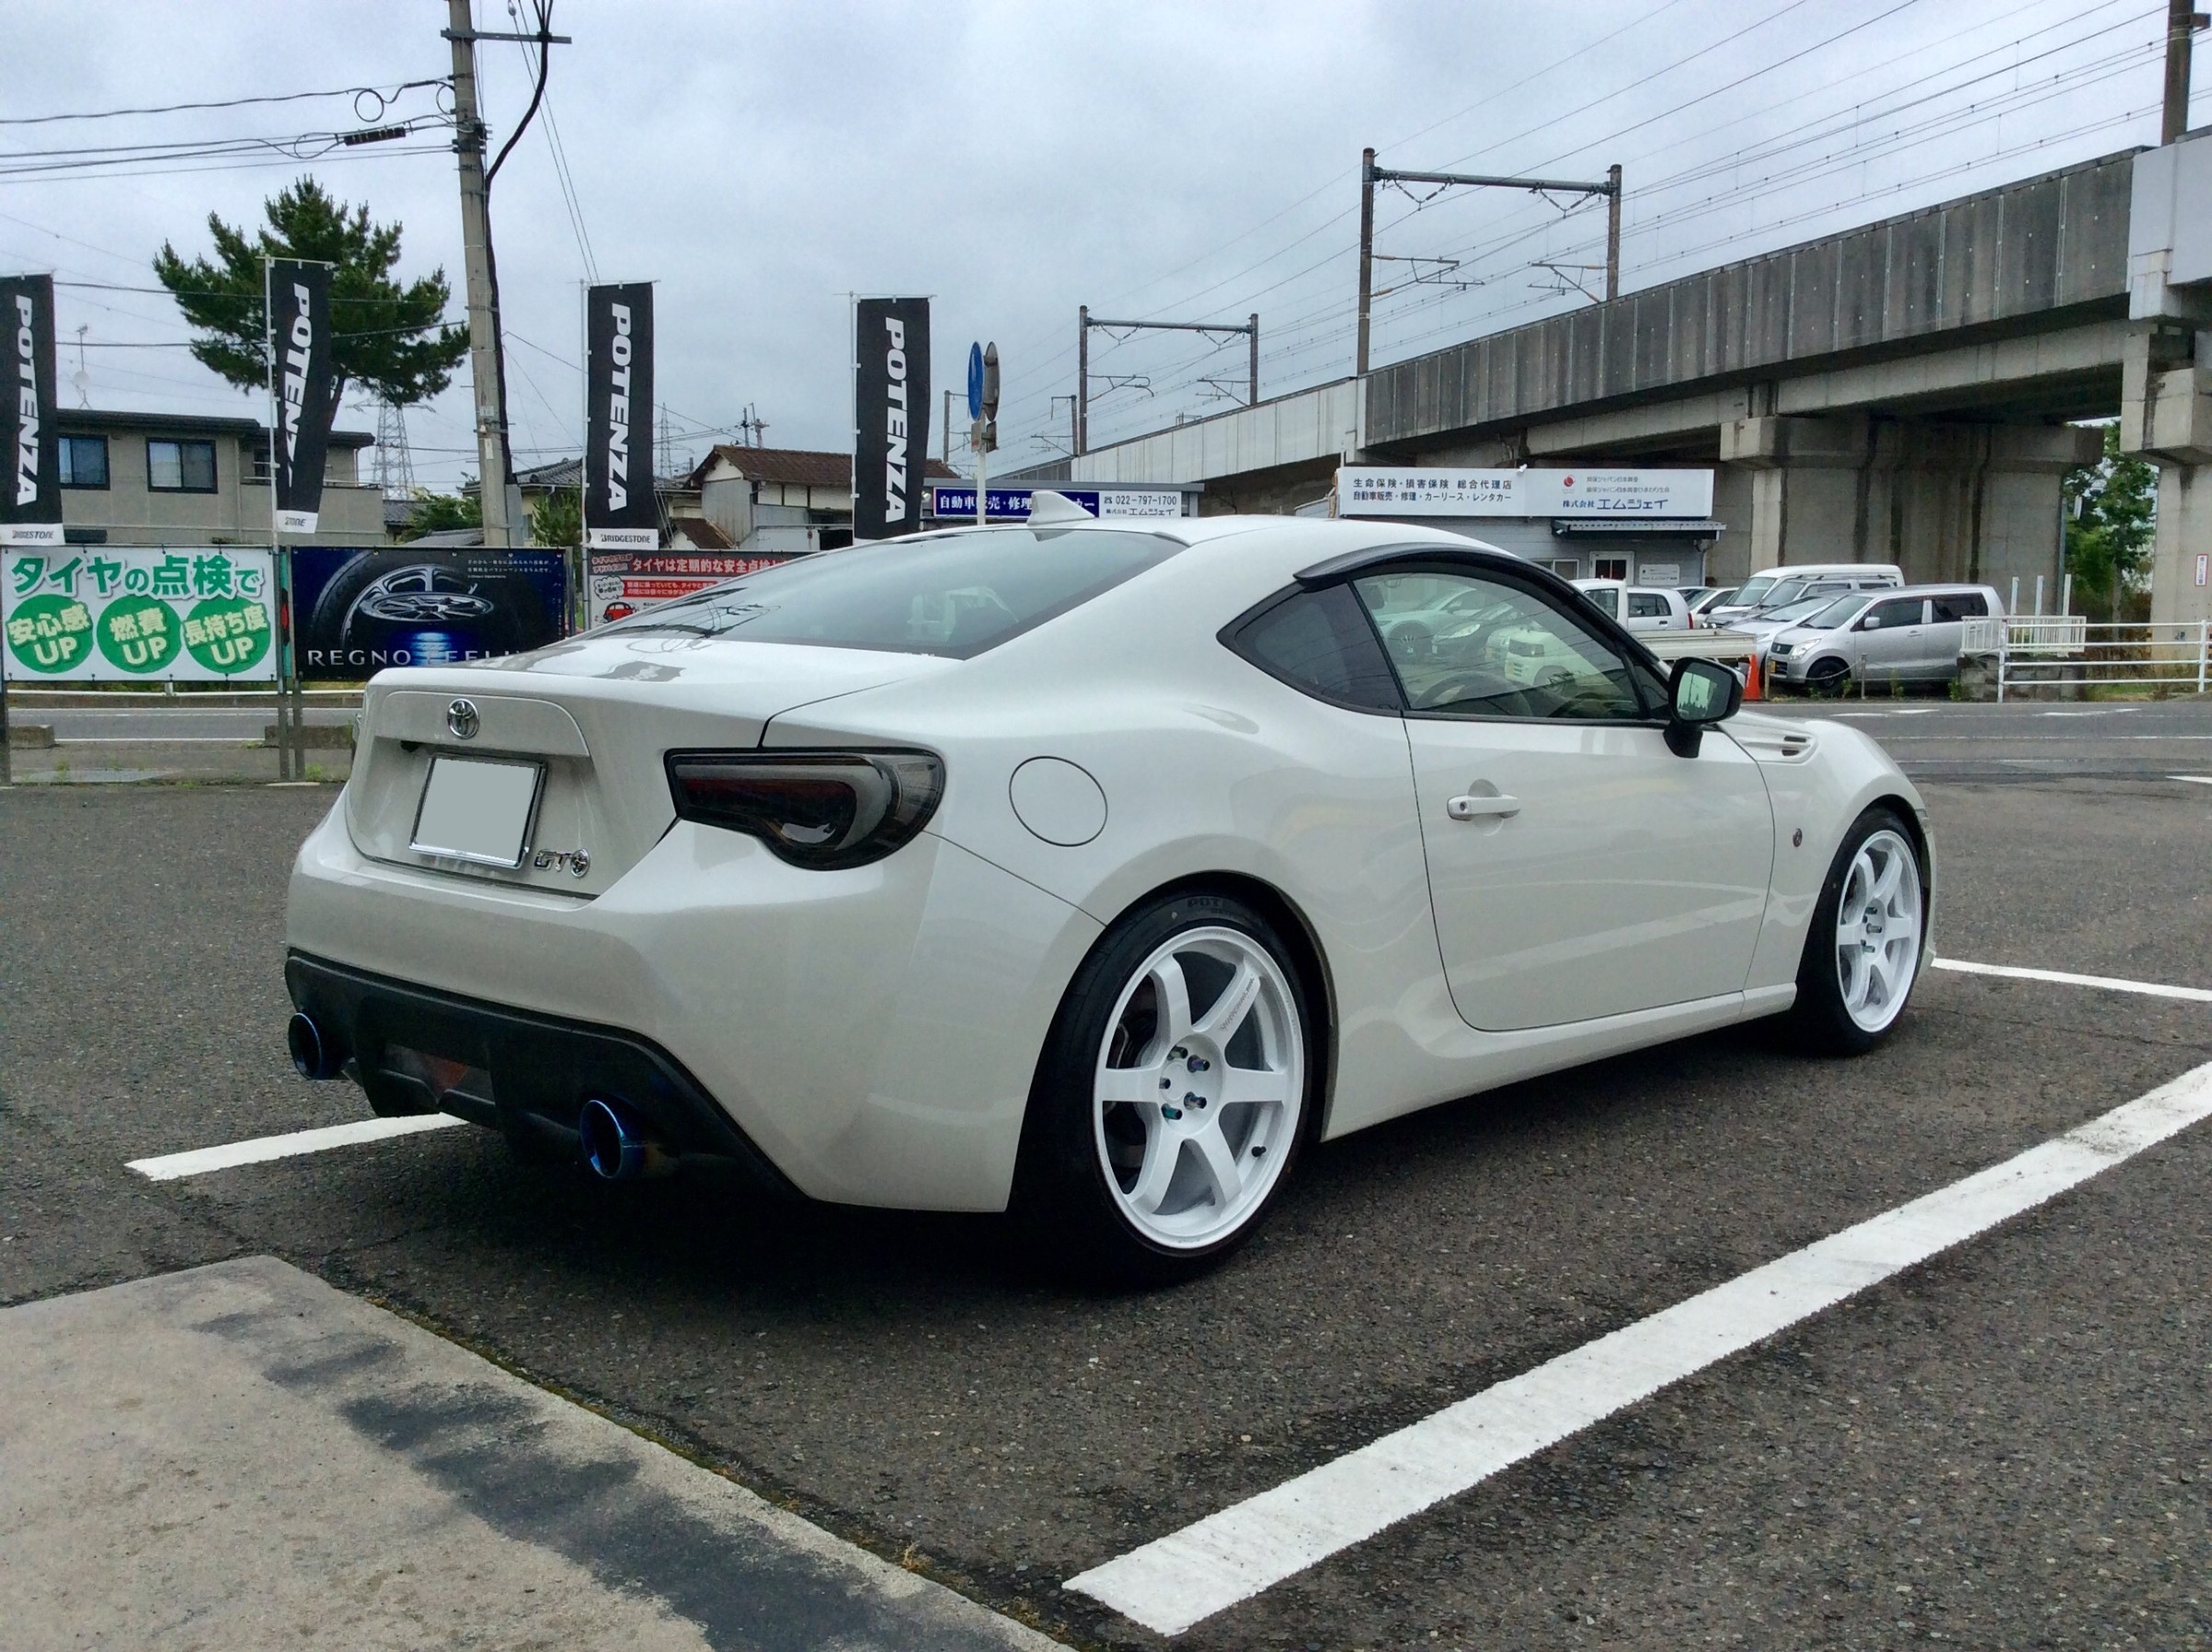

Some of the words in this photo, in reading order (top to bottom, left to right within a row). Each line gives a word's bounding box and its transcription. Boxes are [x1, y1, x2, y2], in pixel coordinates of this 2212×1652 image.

[284, 282, 312, 488] POTENZ
[16, 294, 40, 506] POTENZA
[608, 303, 632, 512] POTENZA
[885, 316, 908, 523] POTENZA
[1353, 478, 1450, 488] 生命保険・損害保険
[1457, 479, 1512, 489] 総合代理店
[1116, 495, 1177, 505] 022-797-1700
[1129, 508, 1175, 516] エムジェイ
[1597, 499, 1668, 510] エムジェイ
[600, 533, 651, 544] BRIDGESTONE
[10, 554, 261, 596] タイヤの点検で
[8, 604, 91, 644] 安心感
[109, 607, 167, 643] 燃費
[185, 604, 268, 645] 長持ち度
[34, 637, 77, 665] UP
[122, 637, 167, 665] UP
[211, 637, 255, 665] UP
[307, 649, 411, 666] REGNO
